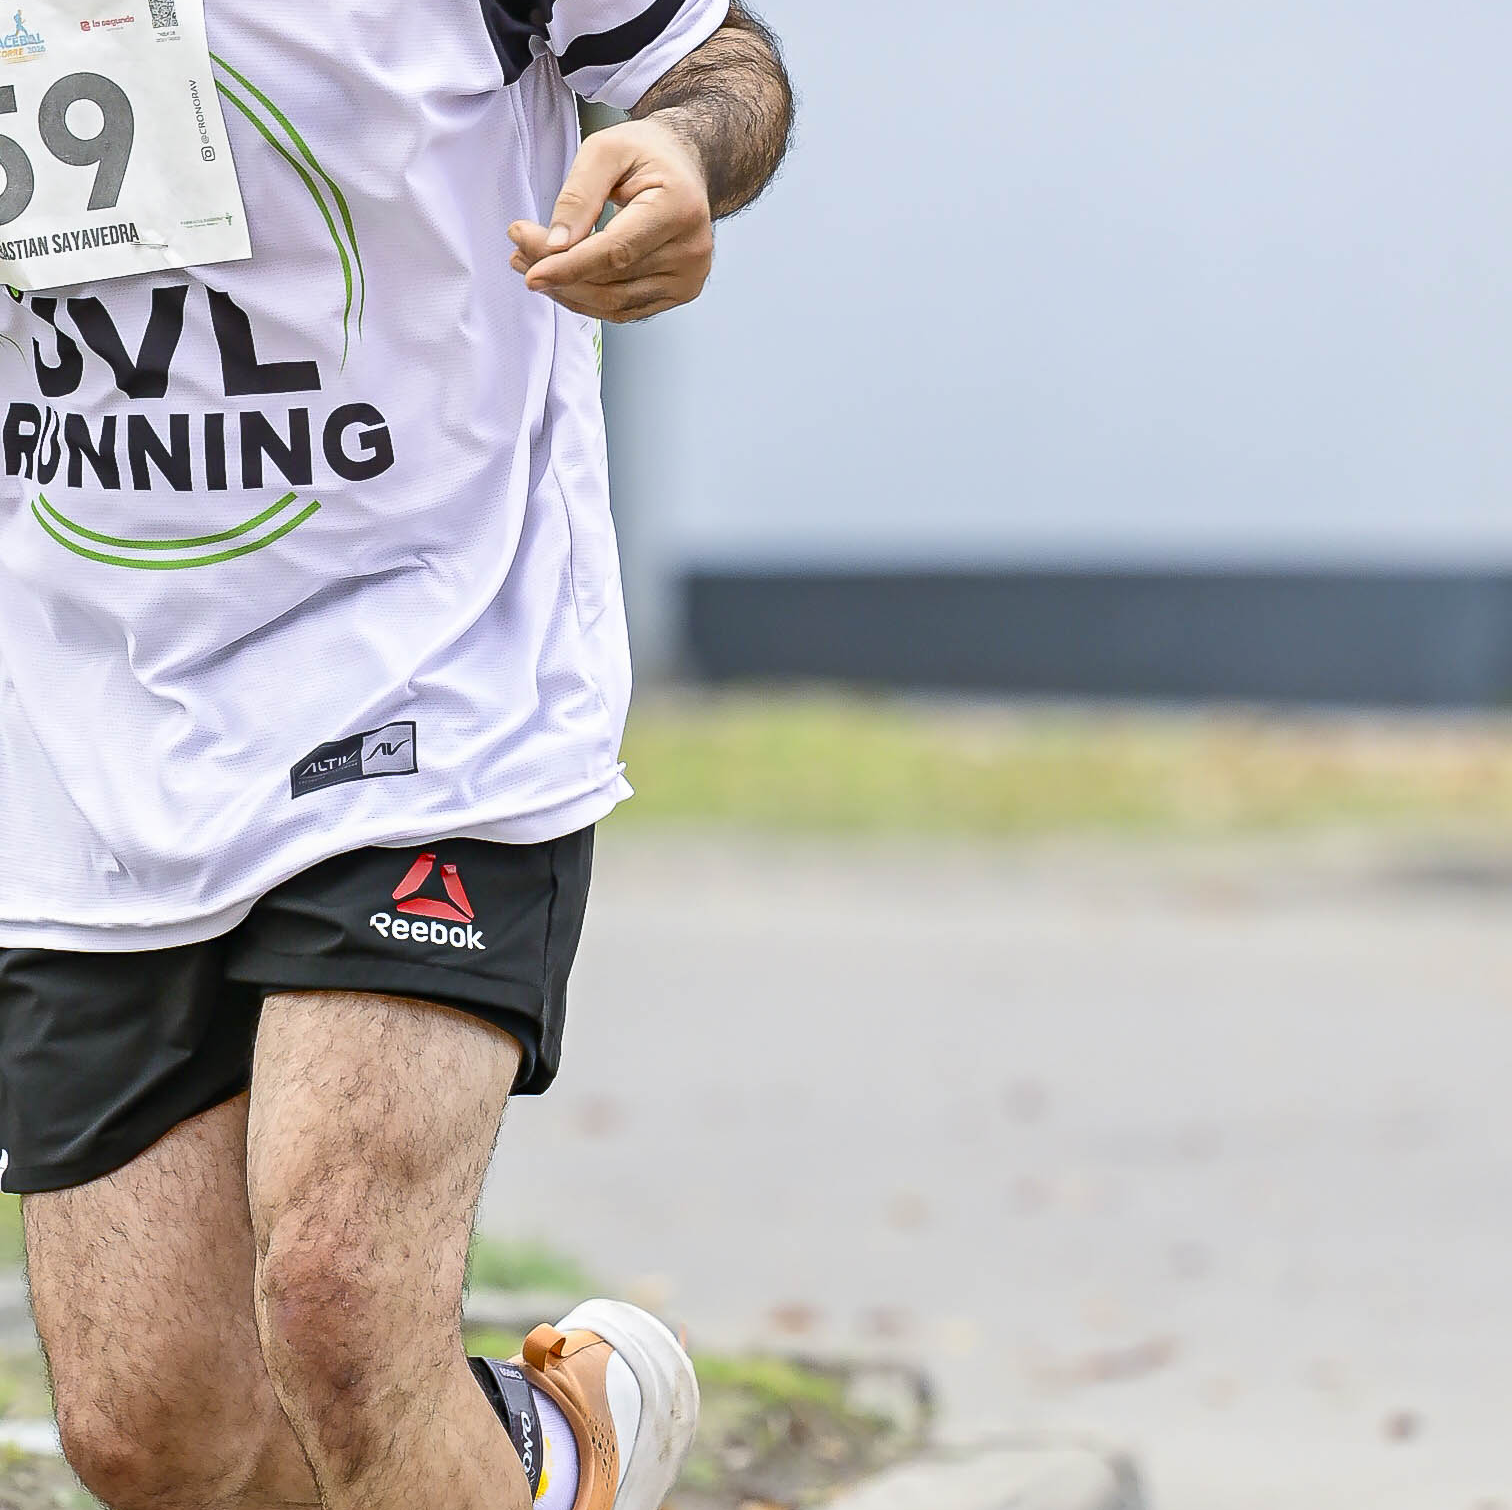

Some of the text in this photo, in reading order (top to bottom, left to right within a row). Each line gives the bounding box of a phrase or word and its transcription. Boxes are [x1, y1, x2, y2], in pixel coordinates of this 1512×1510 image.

[188, 79, 210, 144] @CRONORAV
[51, 222, 140, 254] SAYAVEDRA
[31, 284, 322, 399] JVL
[2, 402, 395, 491] RUNNING
[370, 912, 486, 950] Reebok
